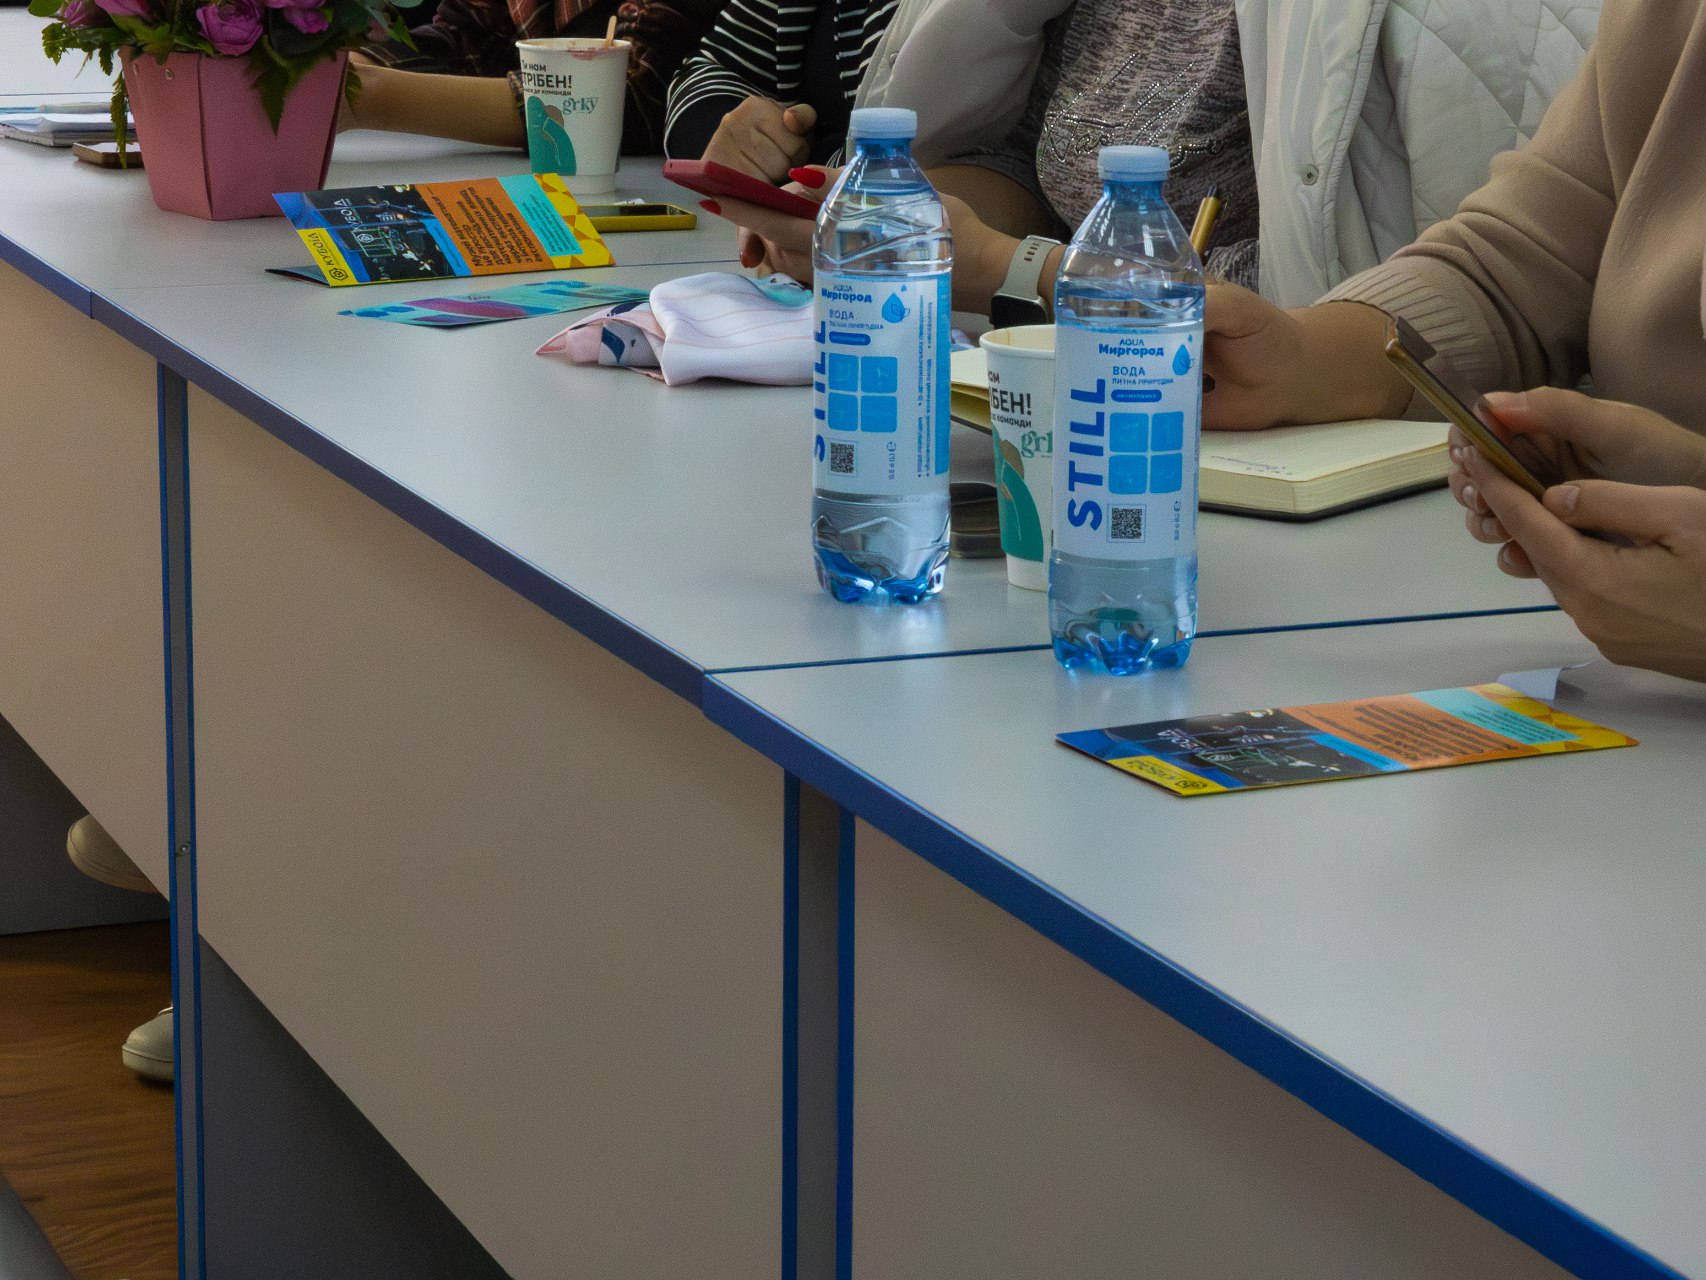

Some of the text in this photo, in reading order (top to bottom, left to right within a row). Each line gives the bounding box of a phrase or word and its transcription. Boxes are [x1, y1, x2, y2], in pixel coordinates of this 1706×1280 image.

[522, 71, 572, 89] ТРІБЕН!
[1119, 338, 1144, 346] AQUA
[1098, 343, 1164, 358] Миргород
[1112, 365, 1146, 377] ВОДА
[1067, 378, 1106, 531] STILL
